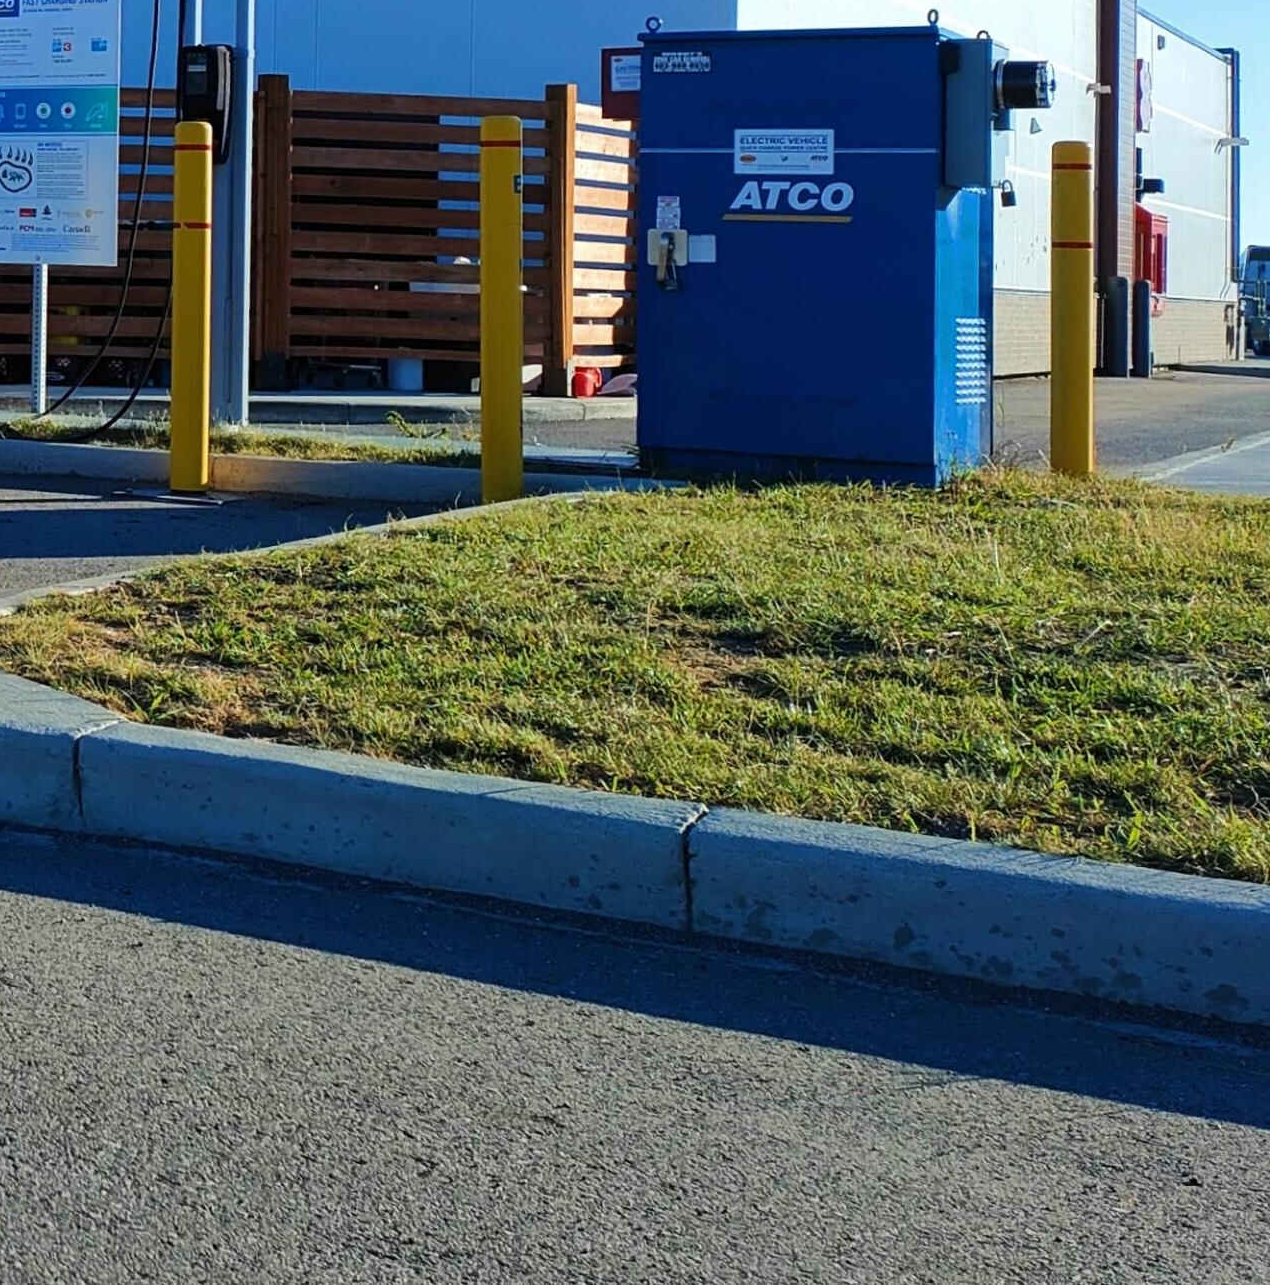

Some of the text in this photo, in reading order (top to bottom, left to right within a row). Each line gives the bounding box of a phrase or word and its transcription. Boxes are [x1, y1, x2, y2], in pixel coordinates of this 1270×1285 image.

[740, 137, 828, 145] ELECTRIC VEHICLE
[729, 180, 854, 211] ATCO
